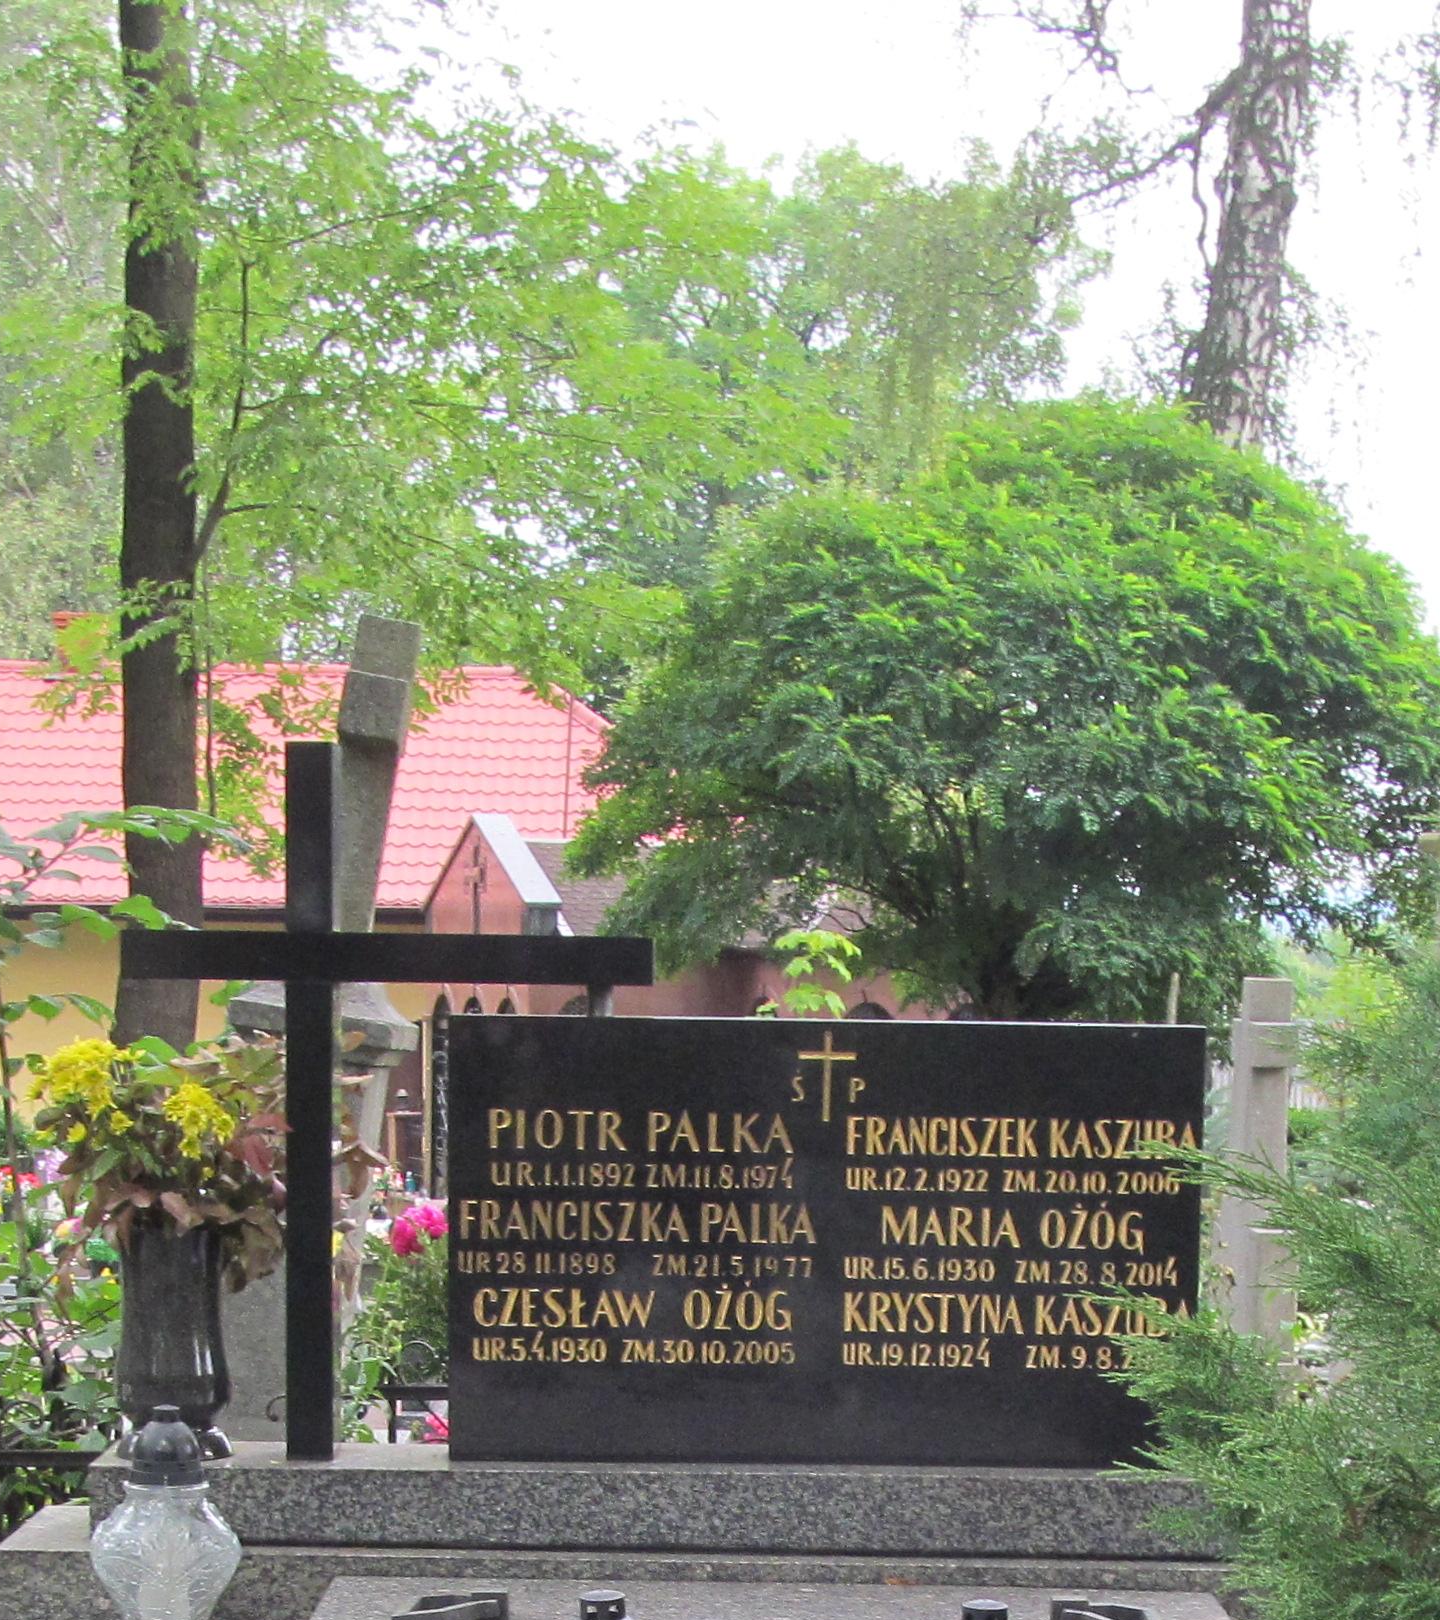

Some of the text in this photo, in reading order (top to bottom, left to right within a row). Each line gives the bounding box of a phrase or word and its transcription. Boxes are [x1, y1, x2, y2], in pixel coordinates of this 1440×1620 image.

[849, 1076, 866, 1103] P
[488, 1108, 795, 1154] PIOTR PALKA
[846, 1116, 1038, 1158] FRANCISZEK
[845, 1167, 989, 1192] UR.12.2.1922
[460, 1200, 817, 1245] FRANCISZKA PALKA
[881, 1201, 1145, 1256] MARIA OŻÓG
[844, 1255, 996, 1283] UR.15.6.1930
[473, 1279, 793, 1332] CZESŁAW OŻÓG
[843, 1291, 1024, 1335] KRYSTYNA
[472, 1330, 608, 1363] UR.5.4.1930
[842, 1337, 991, 1368] UR.19.12.1924
